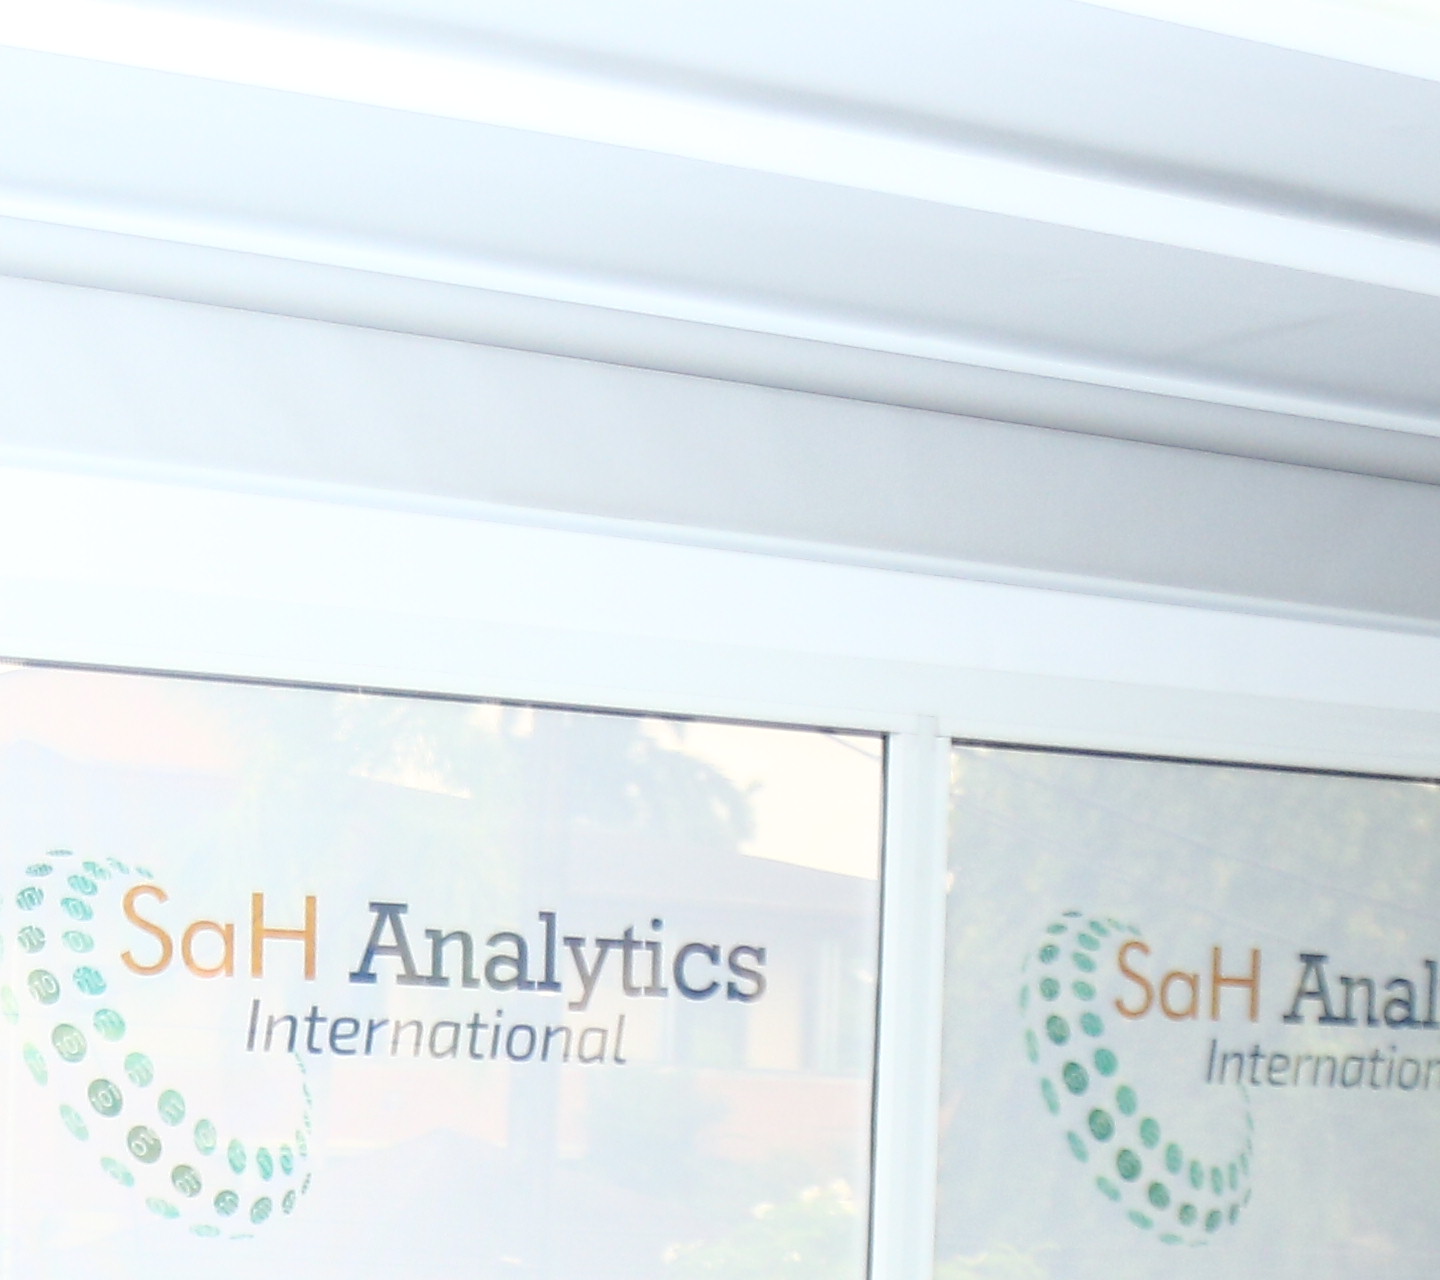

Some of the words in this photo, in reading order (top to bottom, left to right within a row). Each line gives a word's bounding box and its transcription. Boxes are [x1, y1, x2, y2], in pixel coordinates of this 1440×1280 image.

[120, 884, 318, 981] SaH
[349, 902, 768, 1012] Analytics
[1115, 940, 1262, 1022] SaH
[245, 999, 628, 1066] International
